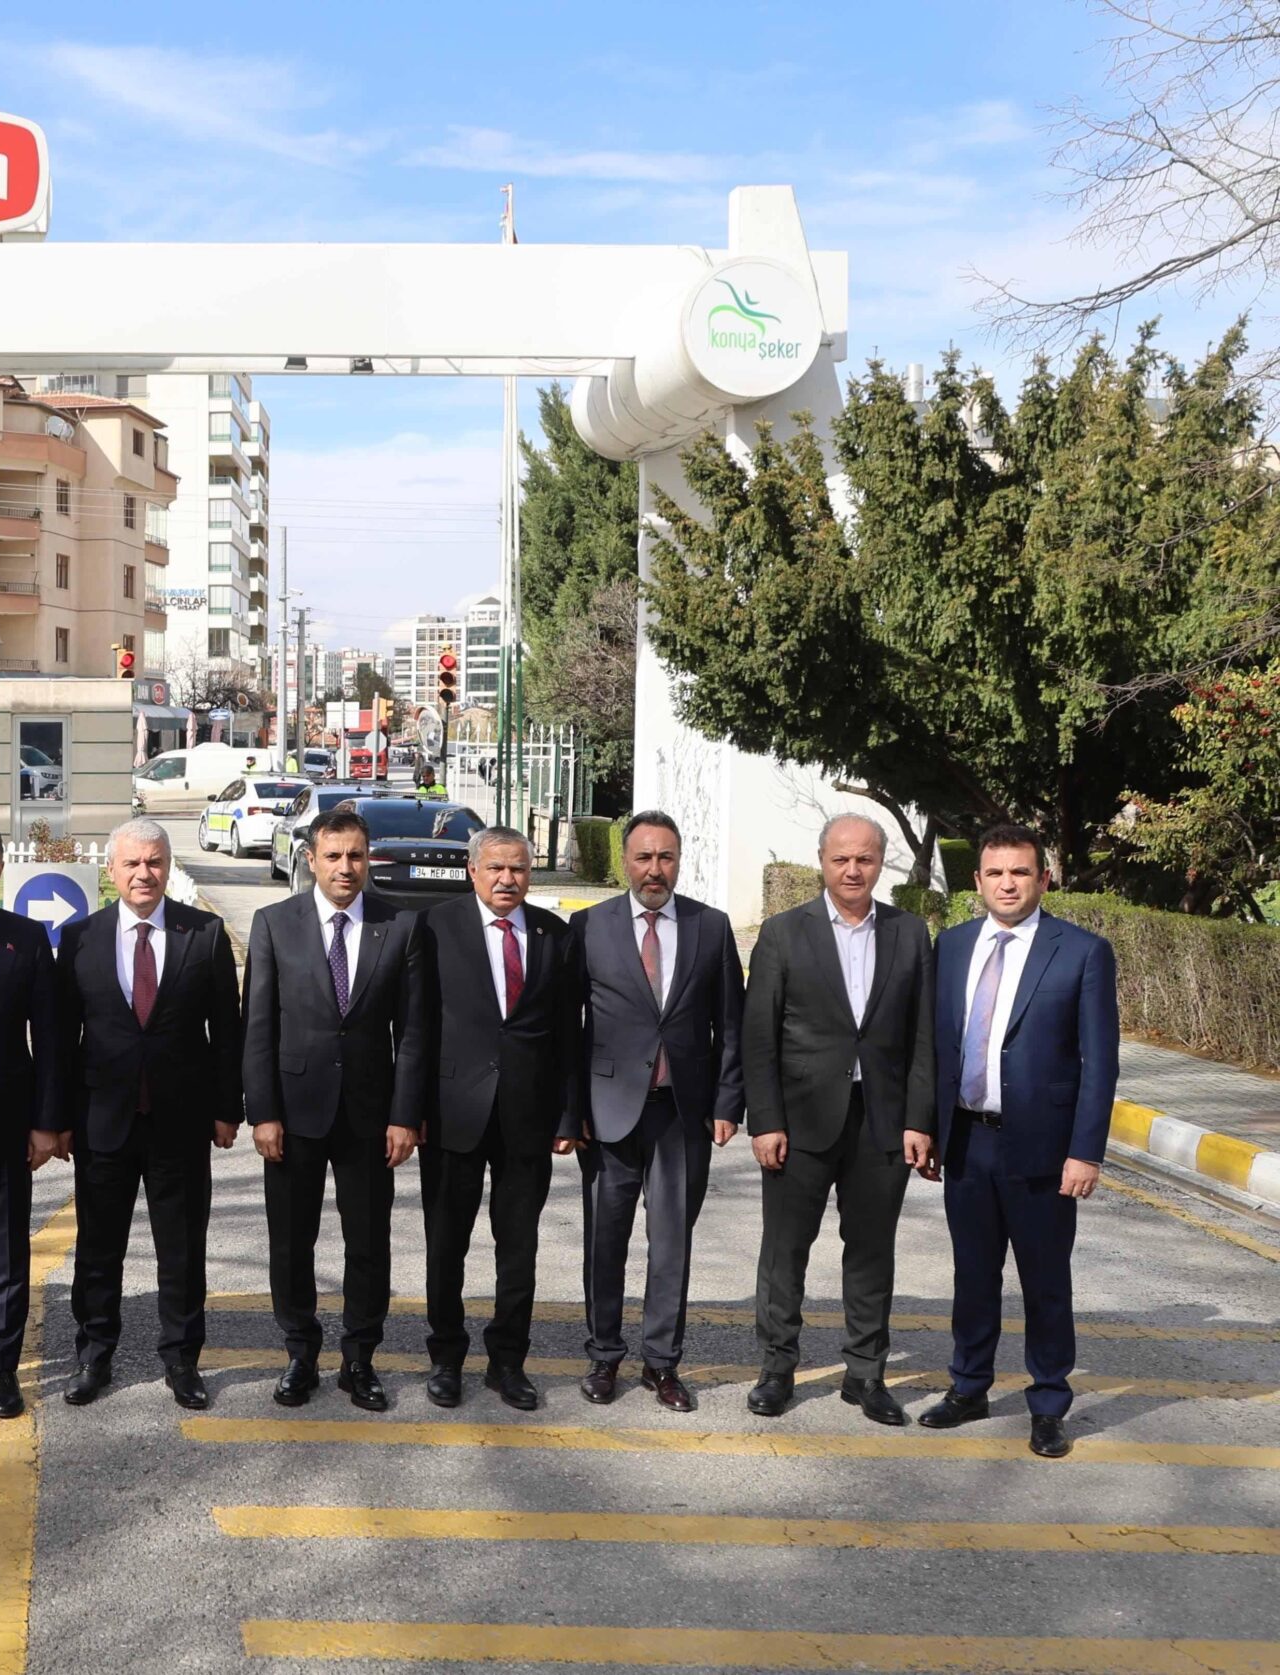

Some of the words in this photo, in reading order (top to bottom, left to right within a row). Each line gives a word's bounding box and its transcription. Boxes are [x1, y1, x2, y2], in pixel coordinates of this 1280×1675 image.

[710, 328, 756, 352] konya
[758, 339, 802, 360] şeker
[416, 868, 426, 877] 34
[430, 868, 446, 878] MEP
[449, 870, 465, 880] 001
